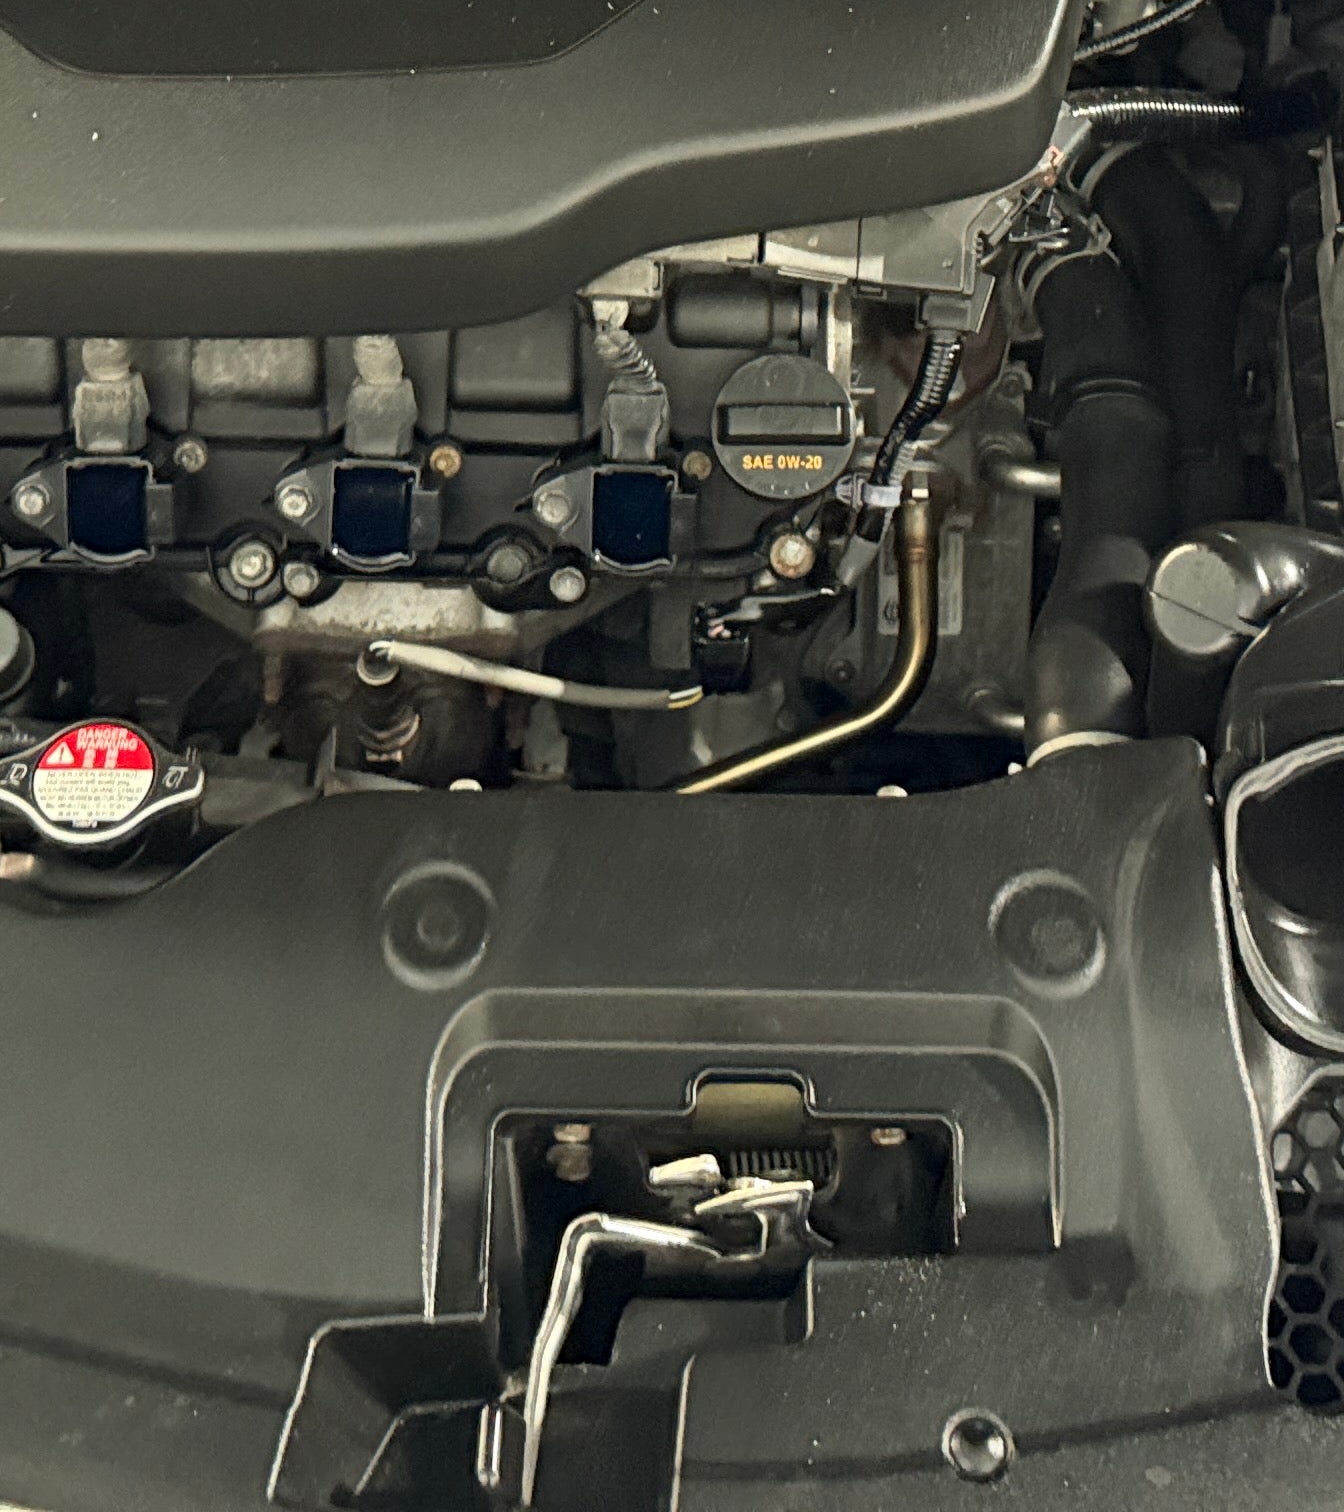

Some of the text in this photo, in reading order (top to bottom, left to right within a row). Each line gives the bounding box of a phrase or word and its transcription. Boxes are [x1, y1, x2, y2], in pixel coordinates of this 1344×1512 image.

[742, 454, 823, 470] SAE 0W-20
[77, 728, 129, 740] DANGER
